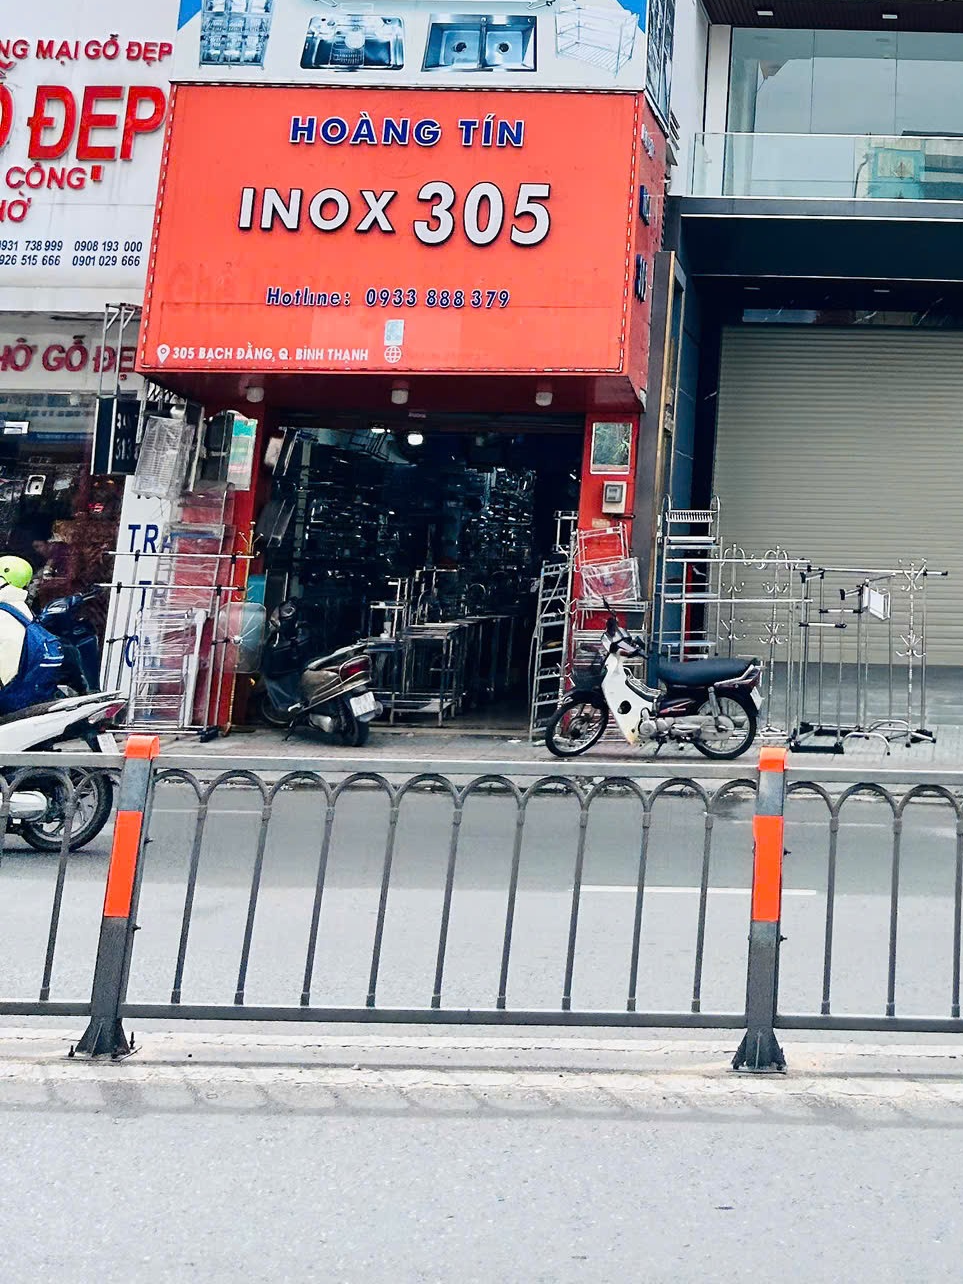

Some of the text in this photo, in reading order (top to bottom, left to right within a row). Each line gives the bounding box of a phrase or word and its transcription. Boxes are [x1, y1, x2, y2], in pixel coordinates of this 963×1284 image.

[35, 40, 80, 65] MẠI
[84, 34, 120, 60] GỖ
[125, 41, 174, 66] ĐẸP
[289, 112, 526, 148] HOÀNG TÍN
[238, 180, 552, 247] INOX 305
[0, 240, 143, 253] 931 738 999 0908 193 000
[20, 254, 38, 266] 515
[41, 255, 61, 266] 666
[72, 255, 96, 267] 0901
[98, 255, 118, 267] 029
[121, 255, 140, 267] 666
[266, 285, 511, 309] Hotline: 0933 888 379
[172, 342, 370, 365] 305 BẠCH ĐẰNG, Q. BÌNH THẠNH
